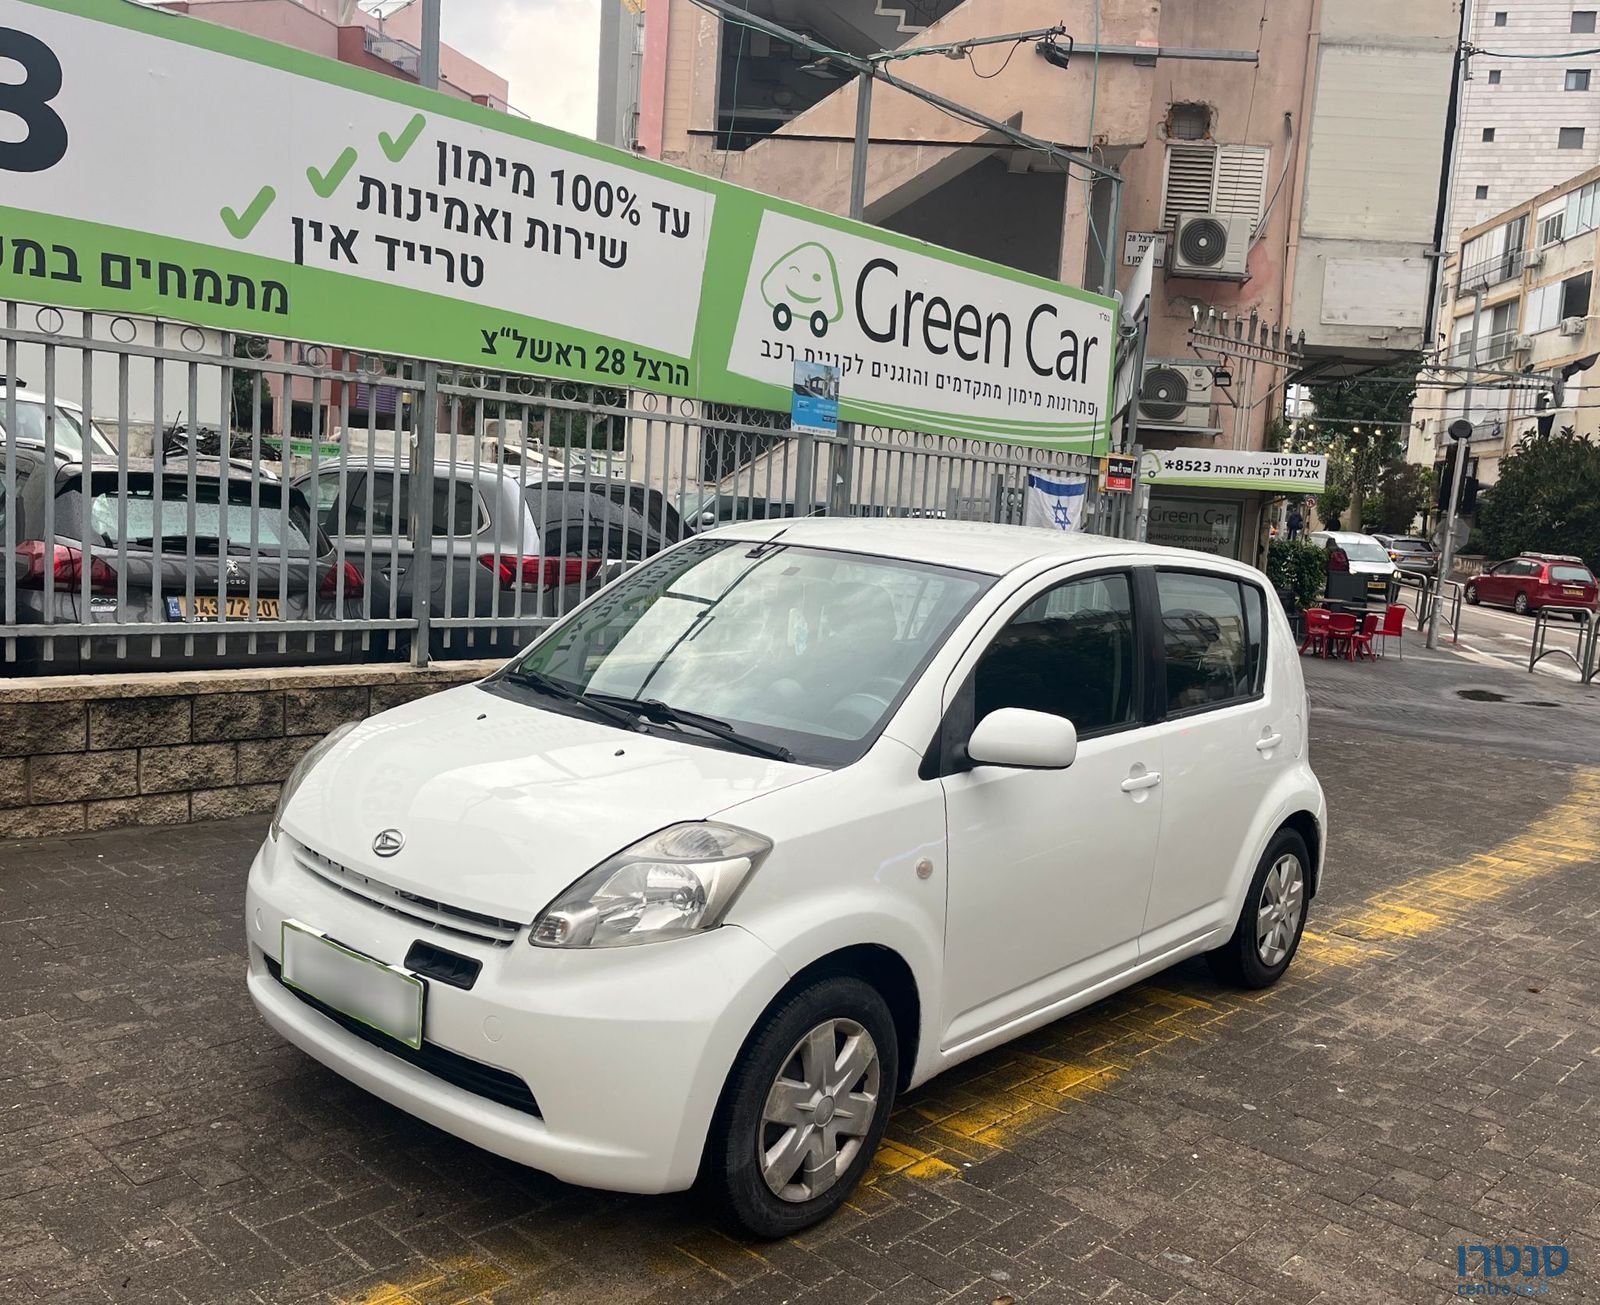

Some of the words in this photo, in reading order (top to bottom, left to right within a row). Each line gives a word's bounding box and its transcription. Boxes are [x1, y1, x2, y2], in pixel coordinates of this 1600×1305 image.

[436, 140, 535, 198] מימון
[356, 175, 512, 244] ואמינות
[550, 169, 641, 226] 100%
[652, 201, 690, 239] עד
[292, 217, 359, 266] אין
[524, 216, 628, 269] שירות
[0, 236, 82, 283] במ
[375, 234, 484, 288] טרייד
[101, 252, 289, 315] מתמחים
[855, 258, 1012, 369] Green
[1025, 303, 1098, 385] Car
[594, 345, 626, 376] 28
[760, 339, 795, 362] רכב
[633, 351, 689, 387] הרצל
[871, 361, 929, 387] והוגנים
[936, 373, 1002, 400] מתקדמים
[1008, 386, 1042, 407] מימון
[1047, 394, 1095, 416] פתרונות
[1214, 464, 1245, 475] אחרת
[1247, 466, 1270, 478] קצת
[1273, 467, 1286, 477] זה
[1289, 467, 1319, 479] אצלנו
[1295, 457, 1320, 468] שלם
[1149, 506, 1199, 524] Green
[1203, 509, 1232, 525] Car
